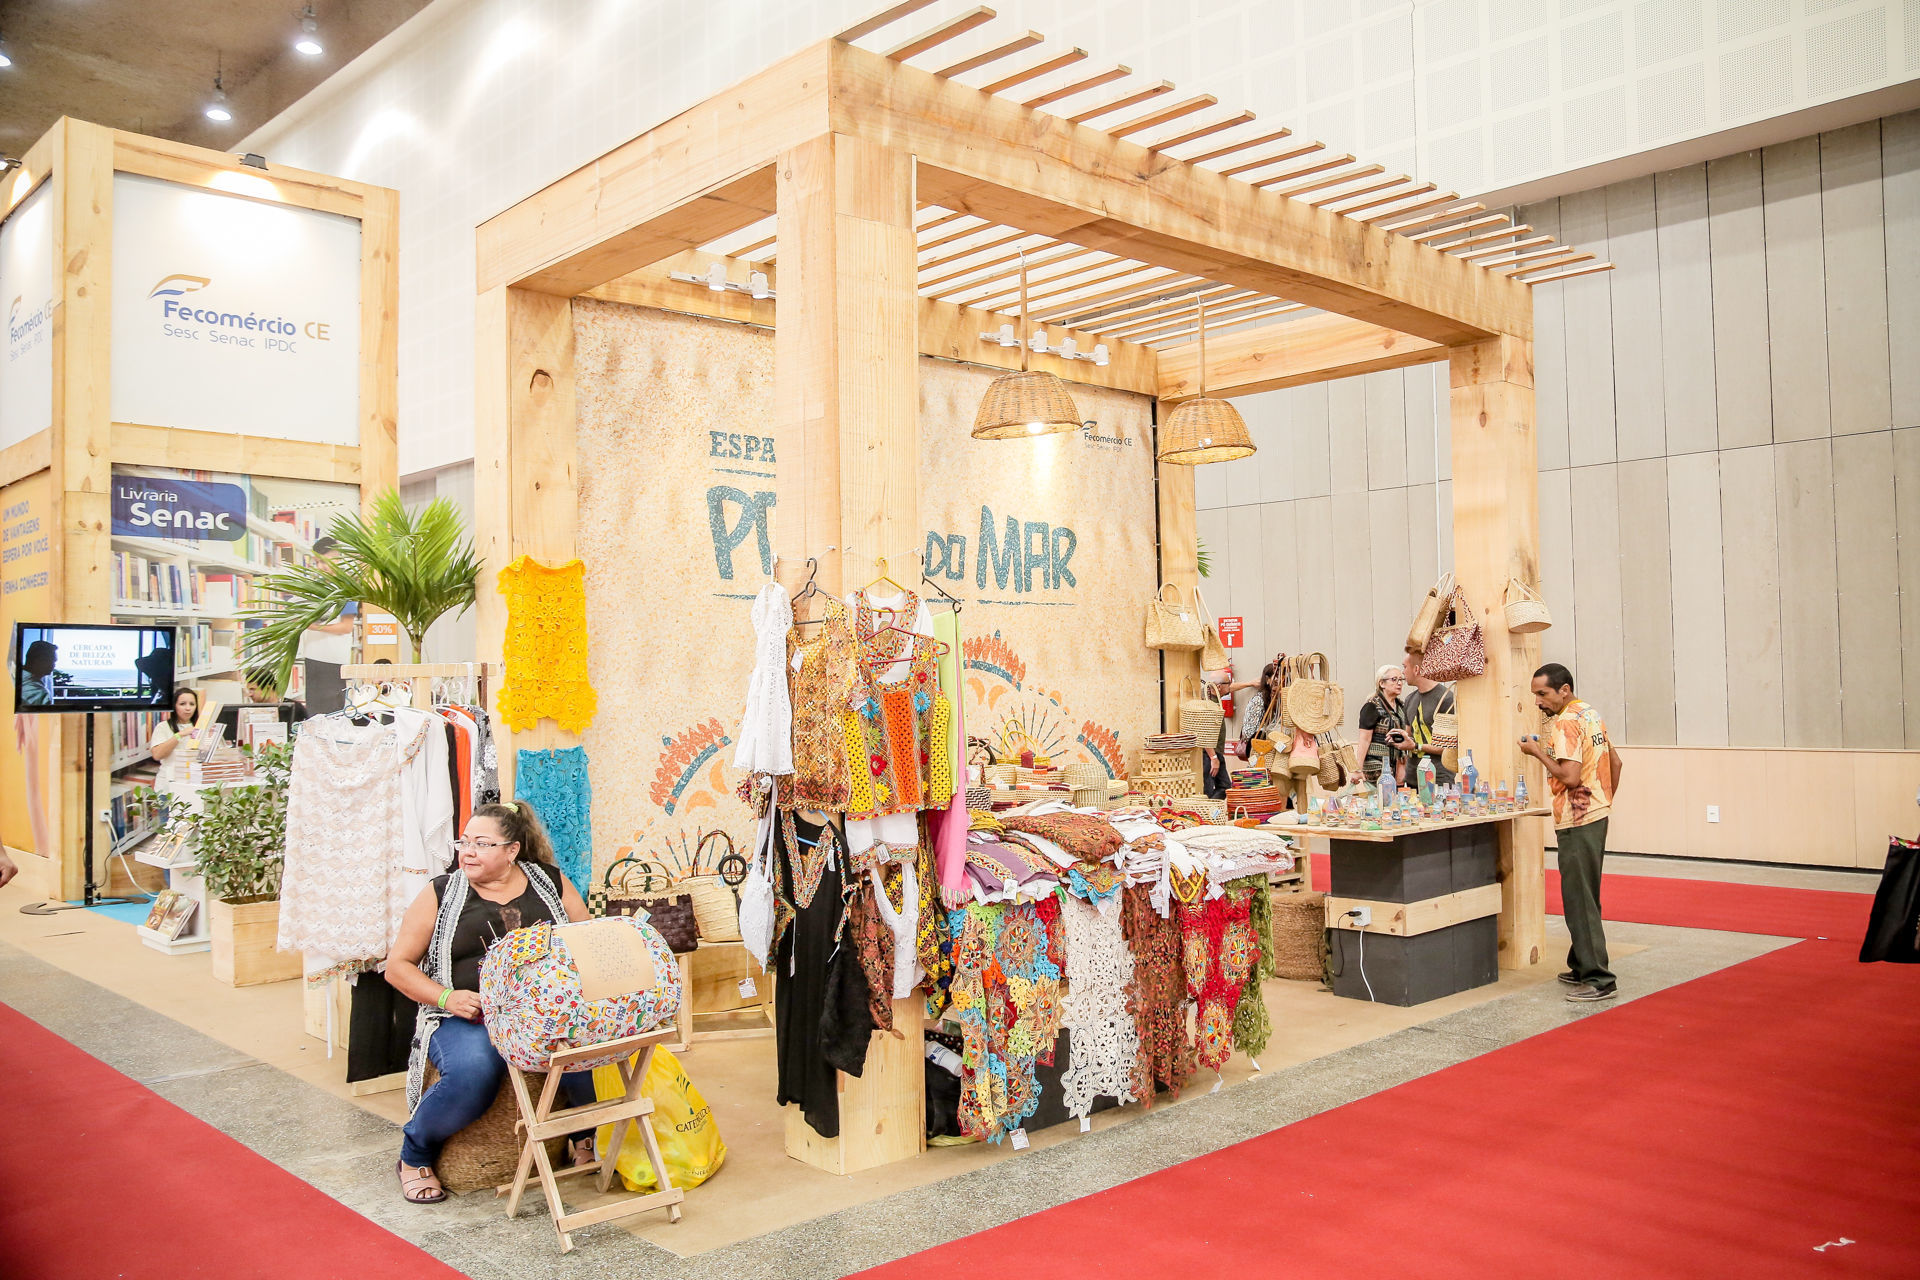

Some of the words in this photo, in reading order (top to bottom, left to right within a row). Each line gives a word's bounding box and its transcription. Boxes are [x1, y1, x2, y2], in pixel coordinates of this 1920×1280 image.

[164, 300, 296, 336] Fecomércio
[304, 321, 331, 341] CE
[163, 323, 199, 340] Sesc
[209, 330, 255, 348] Senac
[265, 338, 297, 354] IPDC
[1084, 432, 1122, 445] Fecomércio
[1124, 437, 1133, 446] CE
[120, 487, 178, 503] Livraria
[129, 502, 230, 531] Senac
[925, 530, 966, 581] DO
[976, 504, 1077, 593] MAR
[372, 624, 393, 634] 30%
[82, 651, 116, 659] BELEZAS
